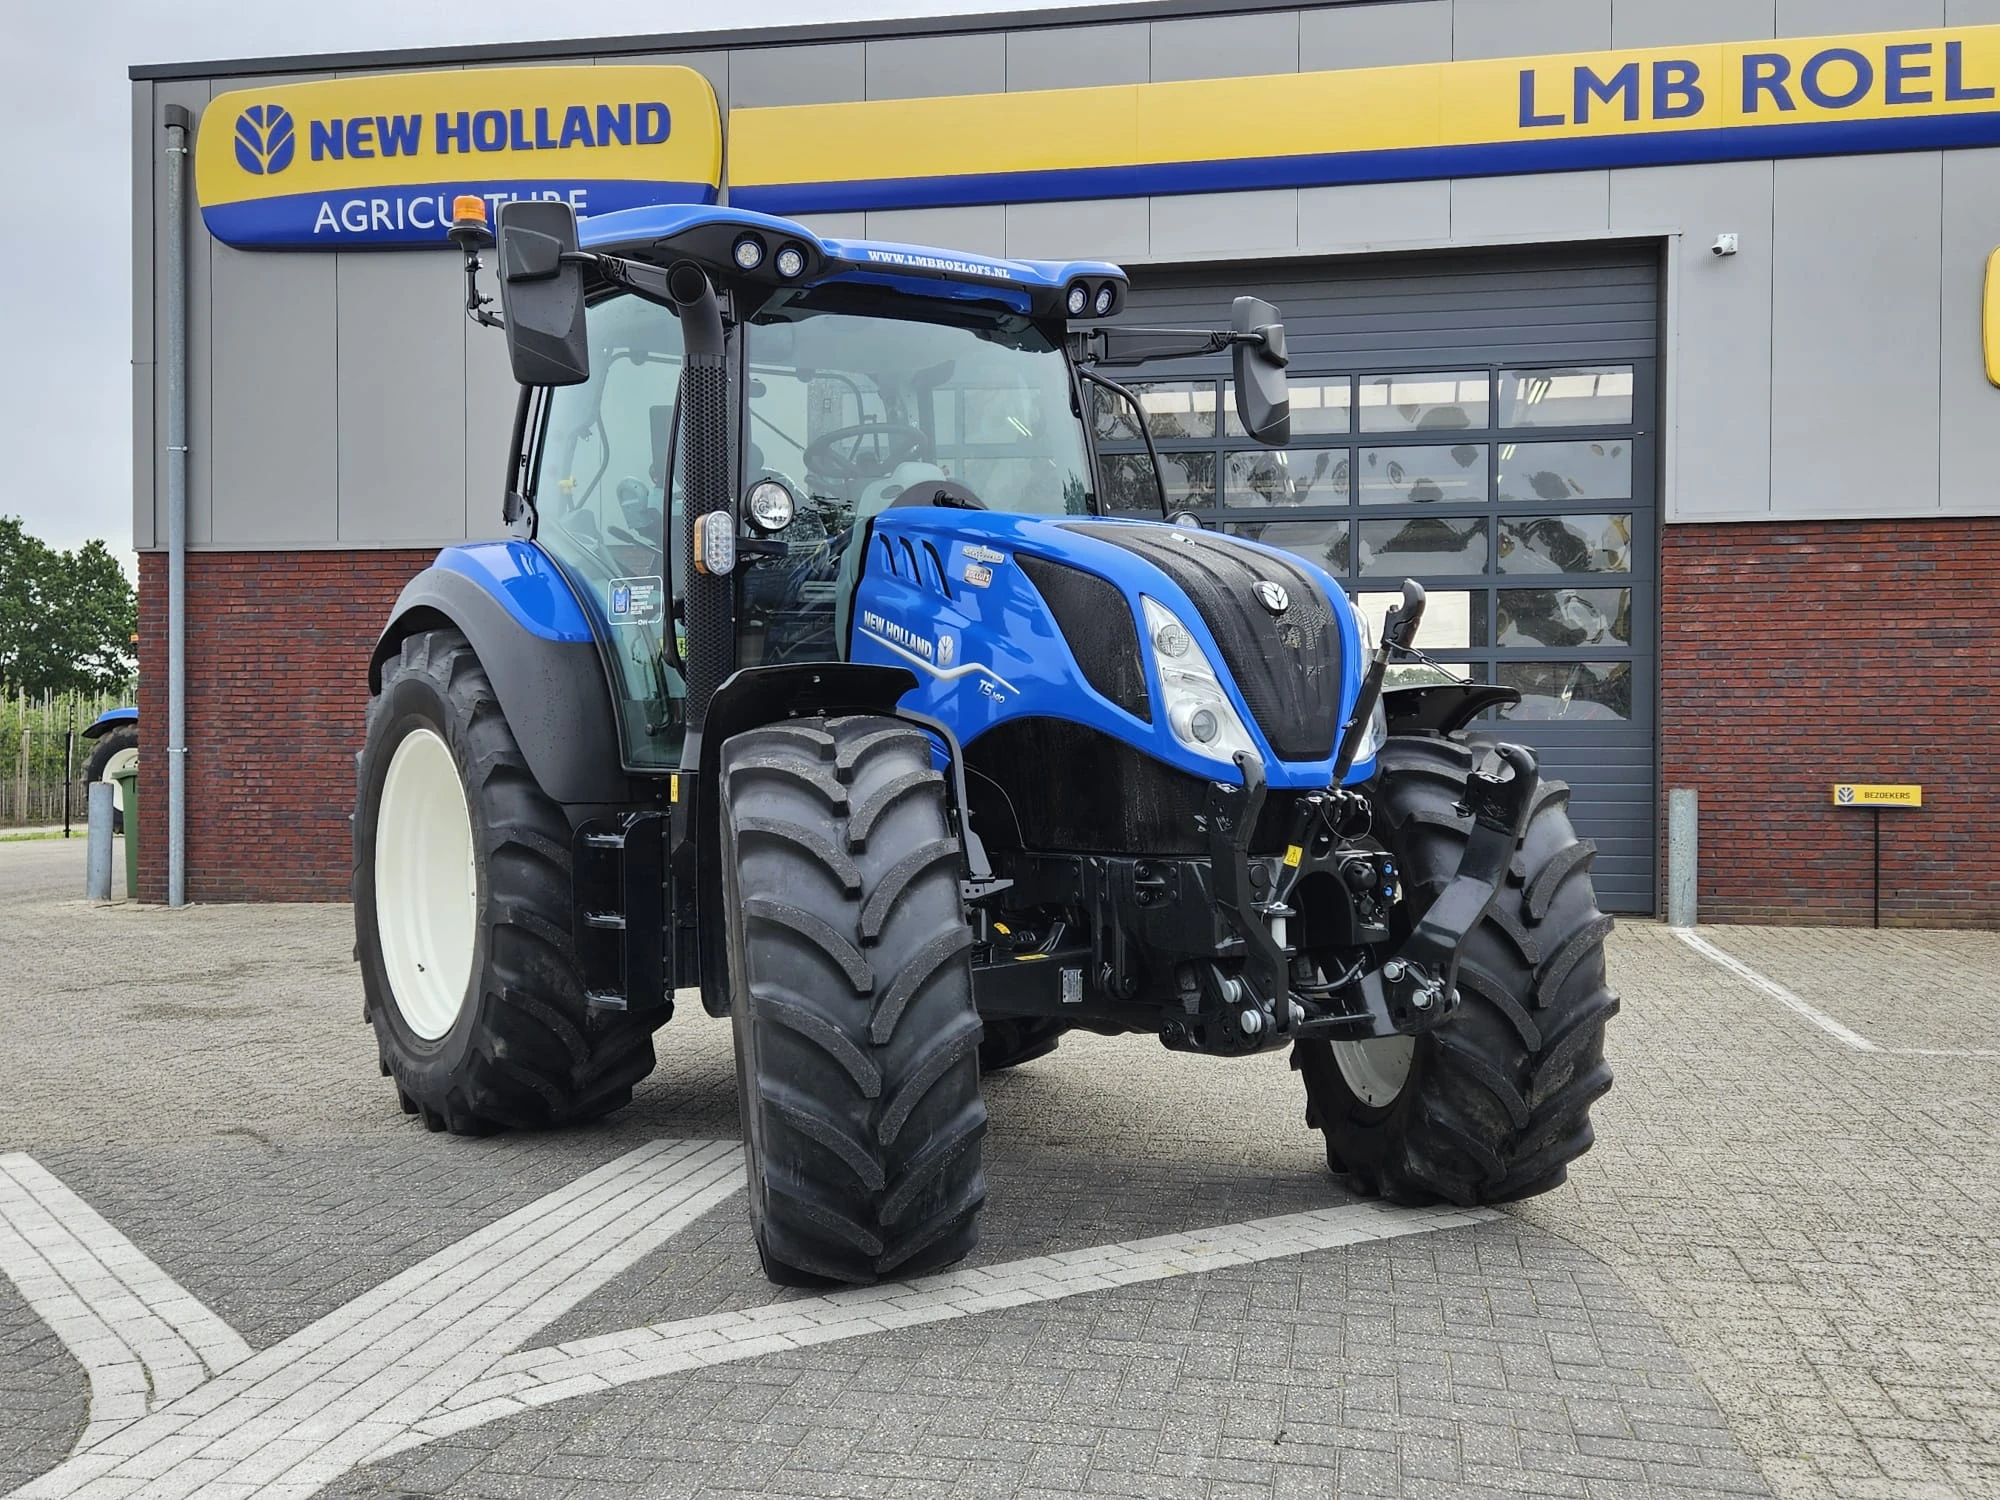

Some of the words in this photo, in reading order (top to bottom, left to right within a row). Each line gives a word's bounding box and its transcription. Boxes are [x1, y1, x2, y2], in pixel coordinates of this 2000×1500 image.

[1518, 60, 1705, 128] LMB
[1741, 41, 1996, 114] ROEL
[310, 114, 422, 161] NEW
[435, 102, 672, 154] HOLLAND
[867, 250, 1011, 279] WWW.LMBROELOFS.NL
[864, 610, 885, 633] NEW
[886, 620, 933, 659] HOLLAND
[1864, 791, 1911, 800] BEZOEKERS
